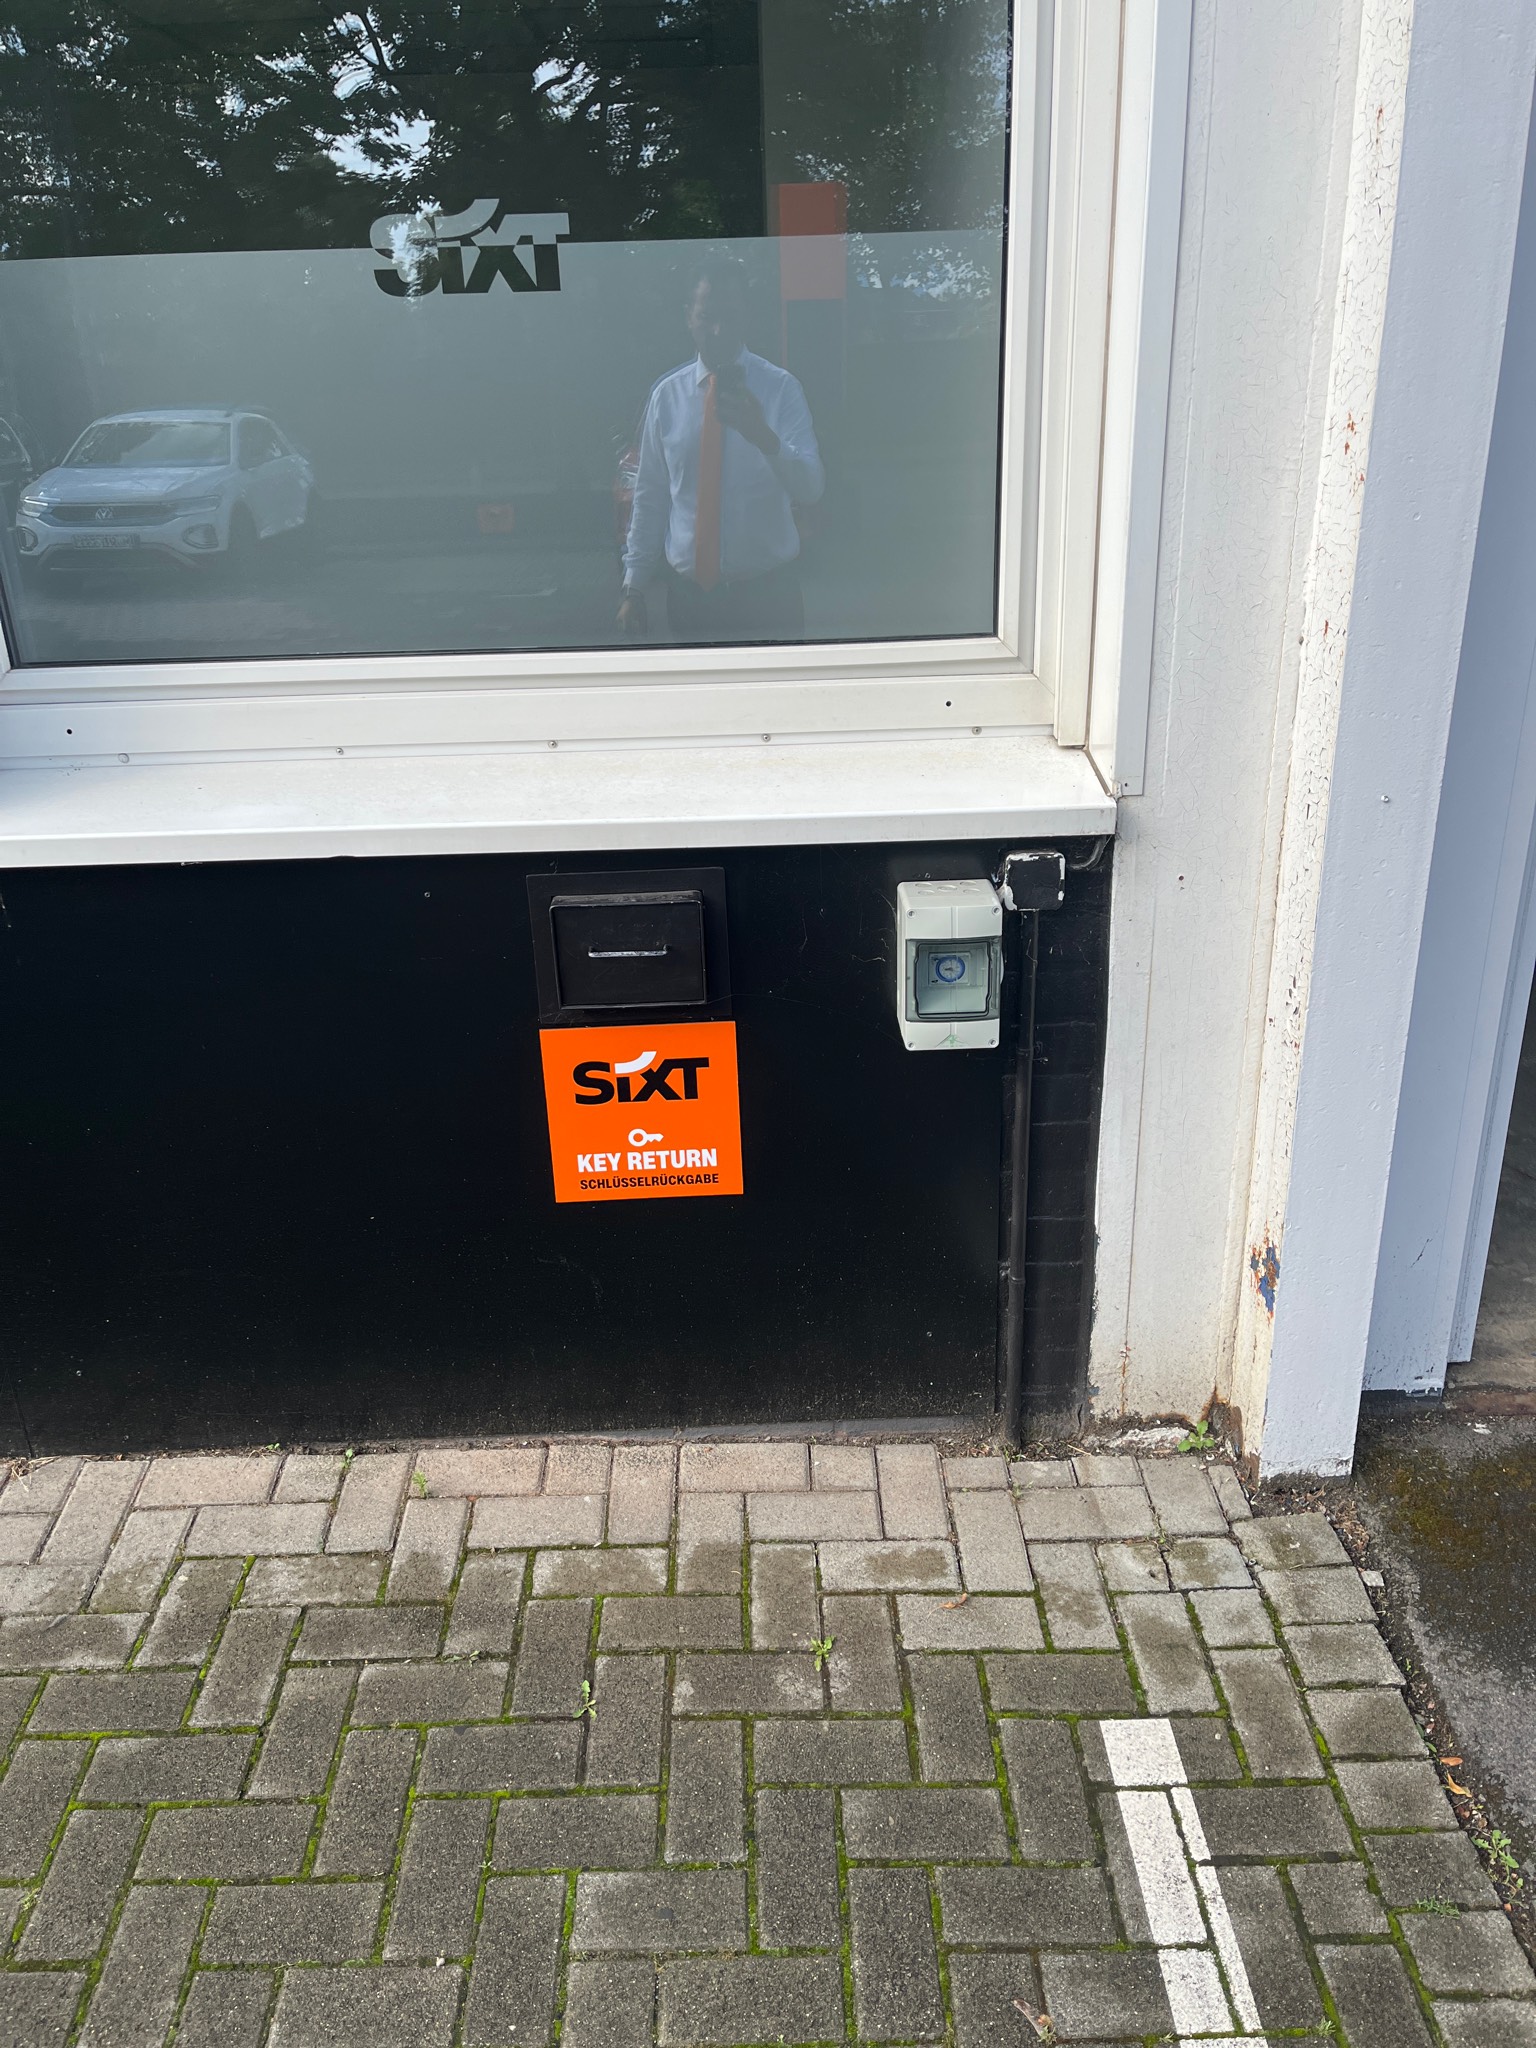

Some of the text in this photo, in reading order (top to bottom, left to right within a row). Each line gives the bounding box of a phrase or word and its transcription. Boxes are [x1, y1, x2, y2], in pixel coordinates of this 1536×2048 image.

[370, 199, 570, 298] SIXT
[572, 1051, 710, 1106] SIXT
[577, 1148, 718, 1173] KEY RETURN
[580, 1173, 720, 1190] SCHLÜSSELRÜCKGABE
